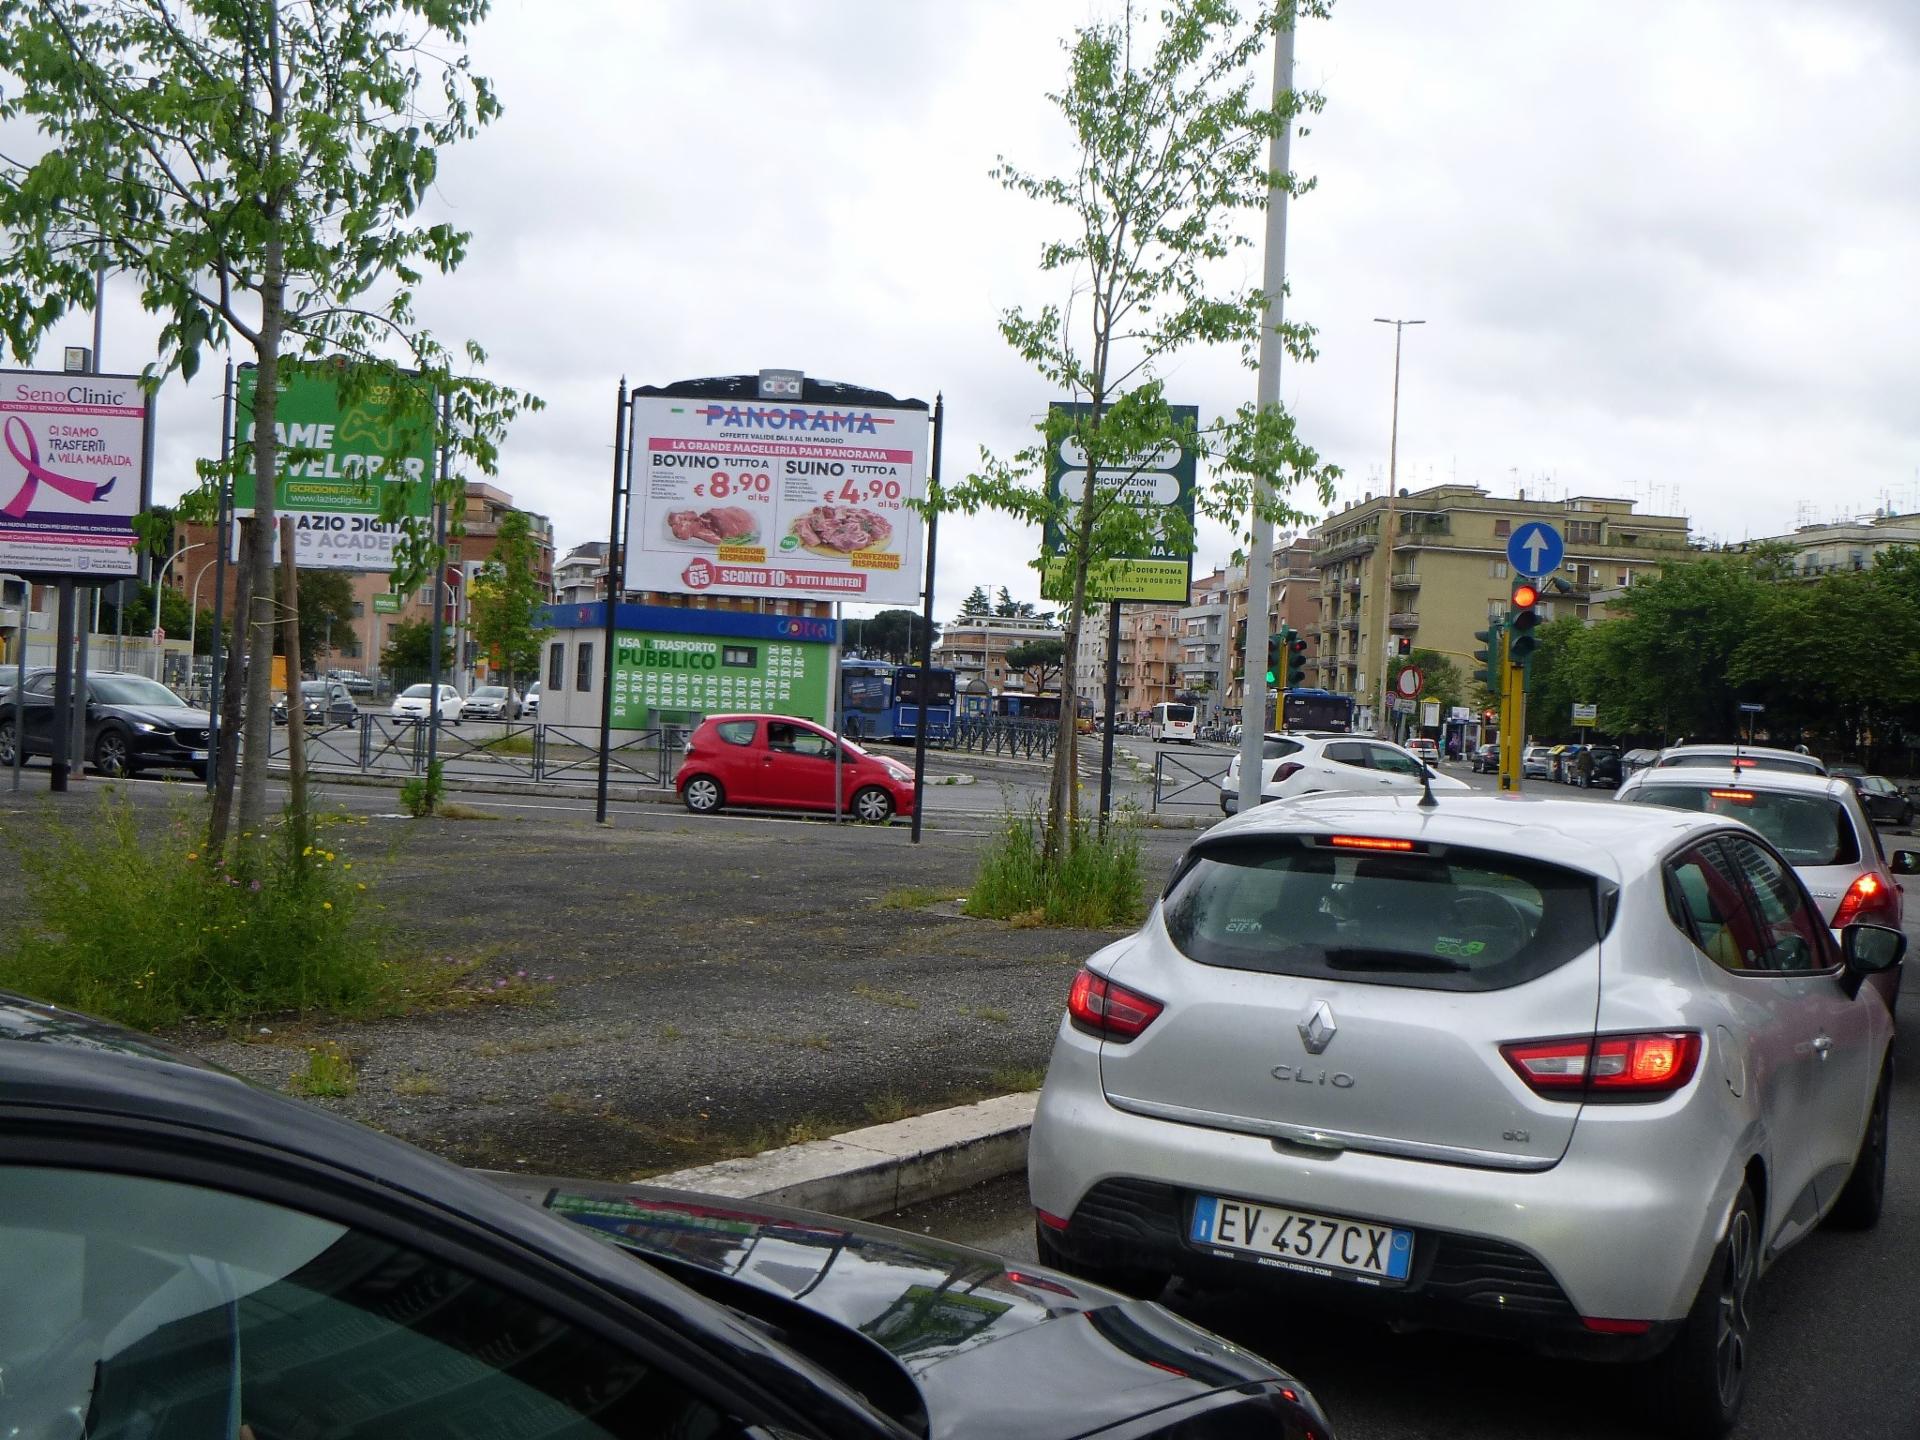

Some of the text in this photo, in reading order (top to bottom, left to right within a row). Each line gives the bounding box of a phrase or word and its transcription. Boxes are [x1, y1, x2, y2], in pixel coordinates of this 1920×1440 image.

[16, 384, 124, 406] SenoClinic
[706, 404, 877, 434] PANORAMA
[49, 425, 99, 438] CI SIAMO
[750, 433, 775, 441] VALIDE
[813, 437, 844, 445] MAGGIO
[49, 439, 106, 452] TRASFERITI
[672, 441, 887, 461] LA GRANDE MACELLERIA PAM PANORAMA
[47, 452, 132, 467] A VILLA MAFALDA
[652, 453, 769, 469] BOVINO TUTTO A
[786, 460, 897, 477] SUINO TUTTO A
[709, 471, 771, 499] 8,90
[838, 479, 901, 505] 4,90
[747, 494, 770, 504] al kg
[888, 501, 900, 511] kg
[852, 552, 900, 562] CONFEZIONE
[852, 560, 900, 570] RISPARMIO
[689, 570, 710, 586] 65
[722, 569, 767, 585] SCONTO
[796, 575, 819, 586] TUTTI
[618, 637, 717, 653] USA IL TRASPORTO
[617, 648, 717, 671] PUBBLICO
[1270, 1063, 1355, 1089] CLIO
[1217, 1203, 1387, 1271] EV 437CX
